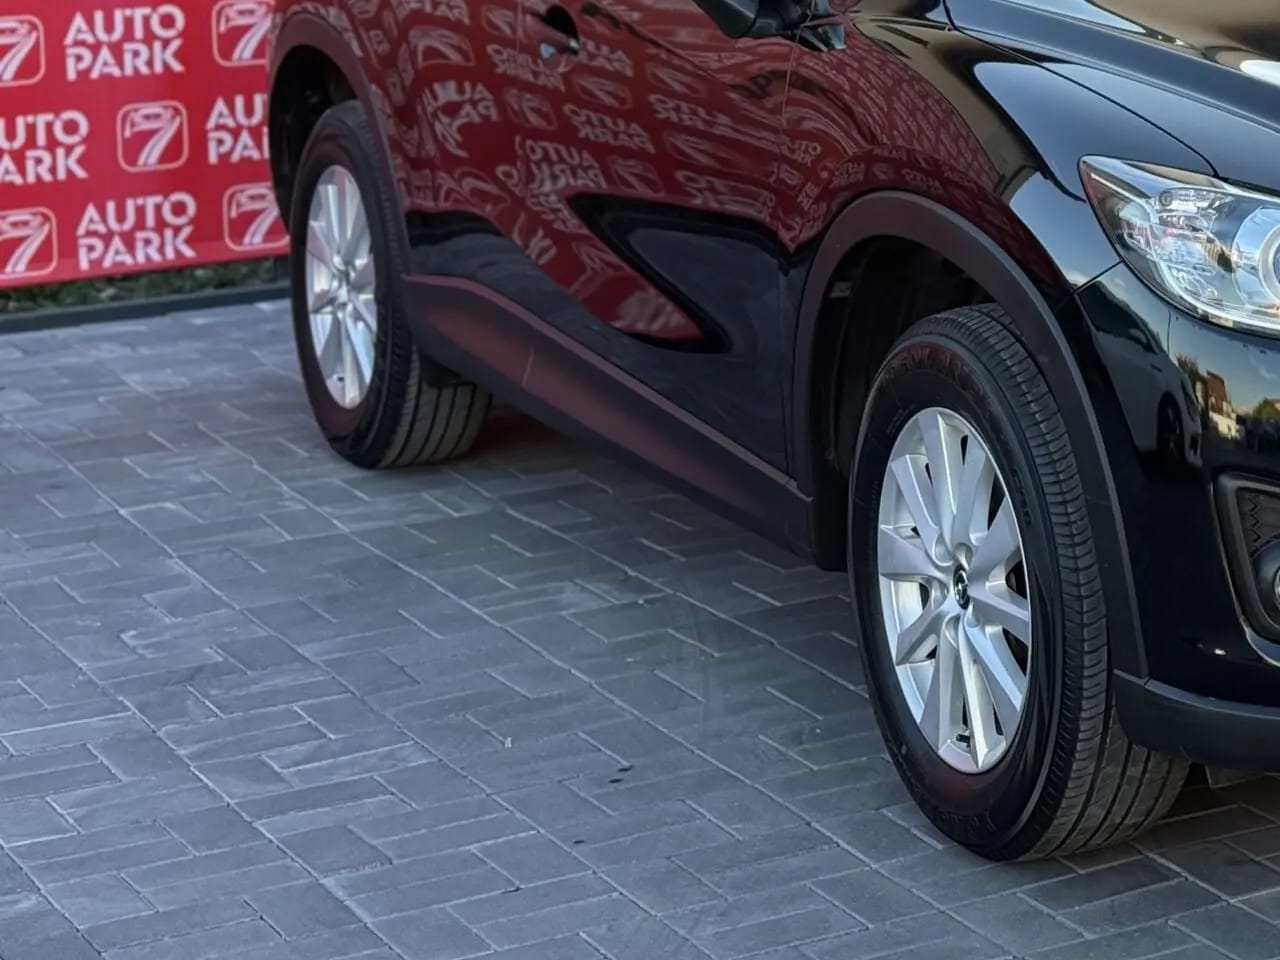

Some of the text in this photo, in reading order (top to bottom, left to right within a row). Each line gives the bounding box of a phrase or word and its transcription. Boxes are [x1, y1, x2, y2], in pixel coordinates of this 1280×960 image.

[64, 4, 185, 46] AUTO
[66, 38, 184, 81] PARK
[77, 192, 196, 236] AUTO
[78, 224, 196, 272] PARK
